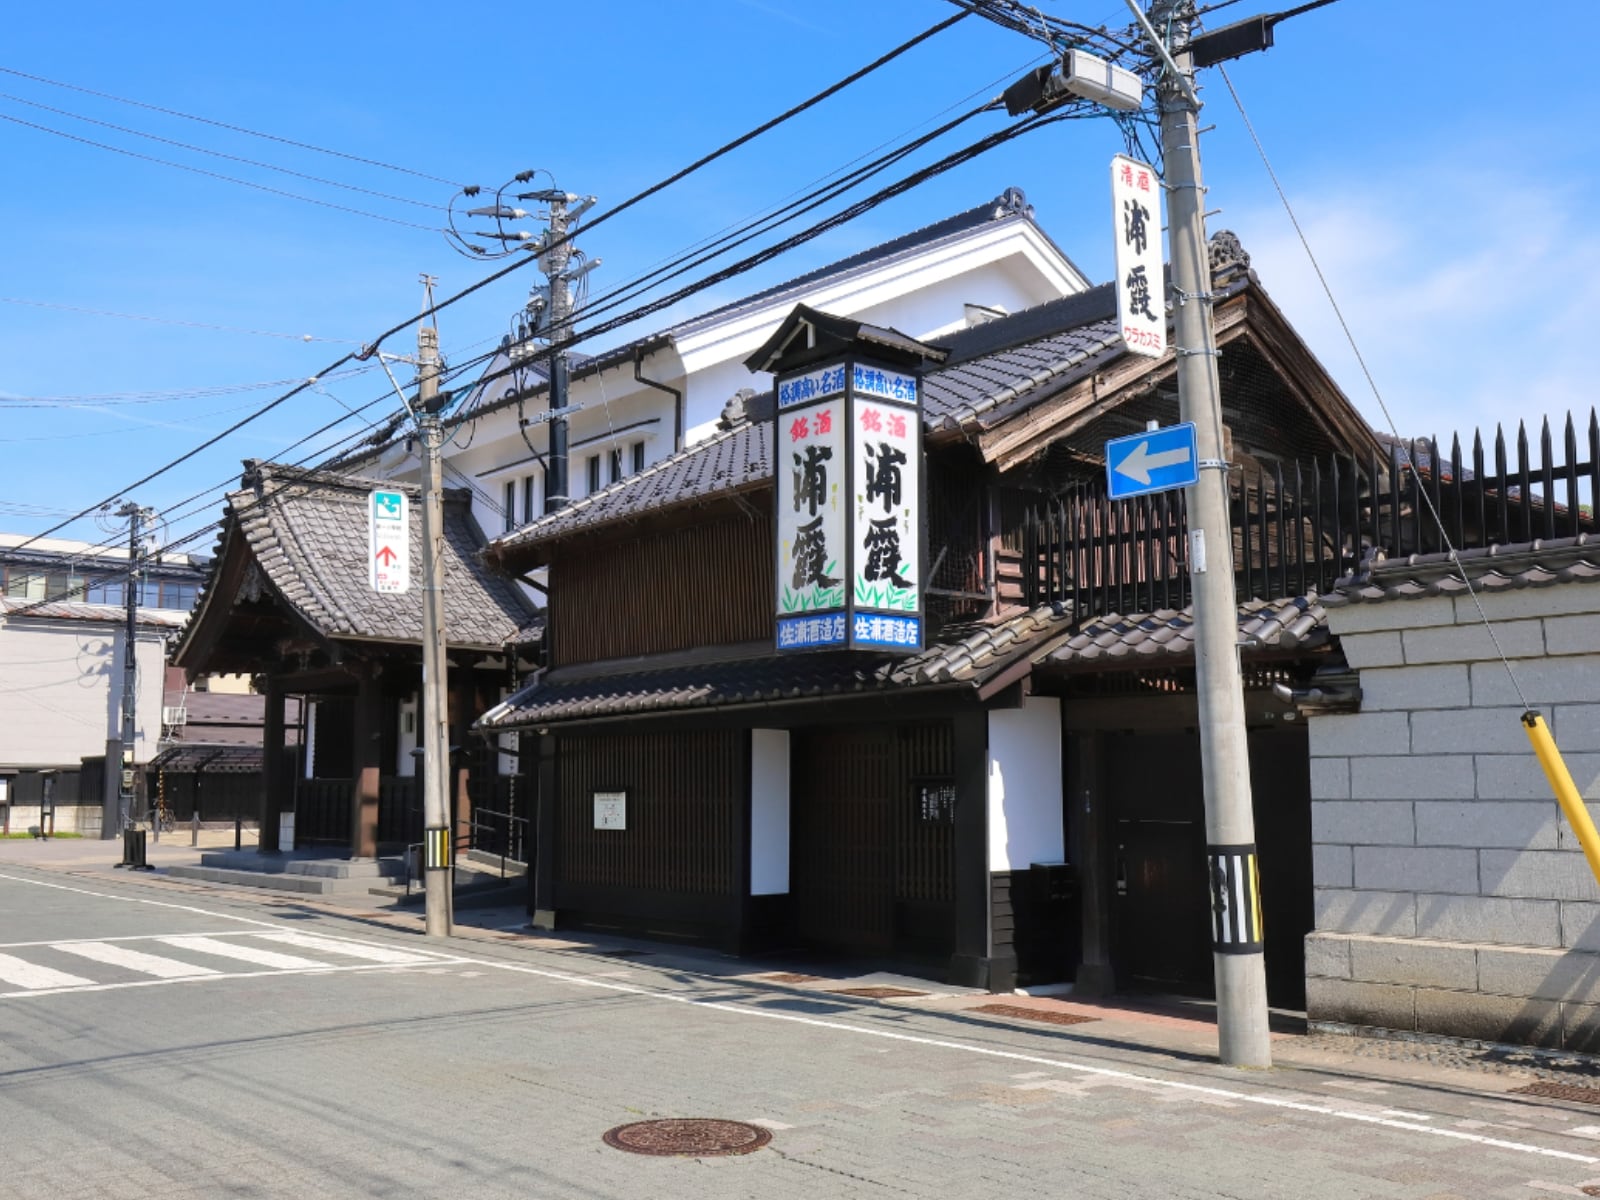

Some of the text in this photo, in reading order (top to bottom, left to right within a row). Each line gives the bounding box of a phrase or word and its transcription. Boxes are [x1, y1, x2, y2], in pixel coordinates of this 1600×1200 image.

[1120, 164, 1150, 192] 清酒
[1124, 198, 1158, 322] 浦霞
[1124, 326, 1161, 350] ウラカスミ
[780, 366, 845, 406] 格調高い名酒
[854, 366, 915, 401] 格調高い名酒
[790, 409, 832, 443] 銘酒
[860, 407, 906, 438] 銘酒
[792, 444, 844, 590] 浦霞
[864, 440, 917, 589] 浦霞
[780, 615, 845, 646] 佐浦酒造店
[854, 616, 918, 645] 佐浦酒造店
